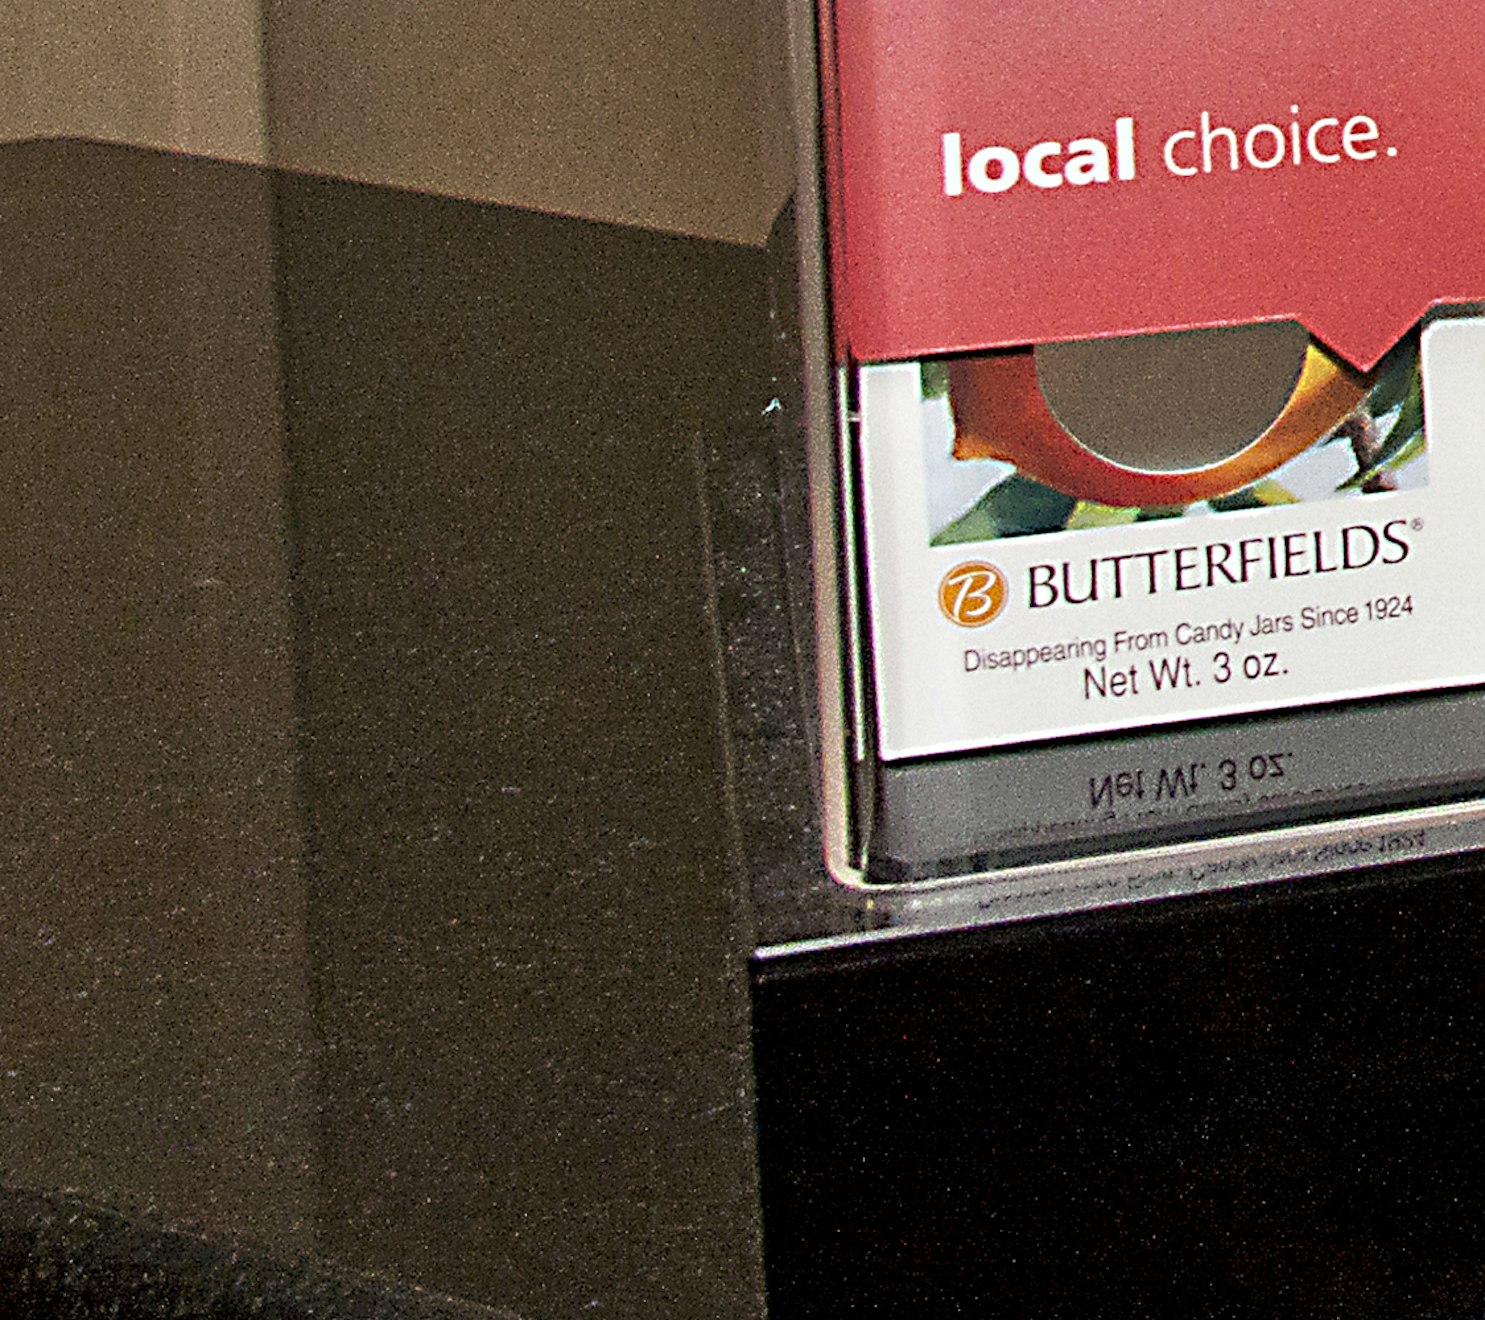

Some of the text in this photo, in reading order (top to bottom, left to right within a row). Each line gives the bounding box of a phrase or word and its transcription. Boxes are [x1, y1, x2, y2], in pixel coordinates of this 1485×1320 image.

[942, 104, 1399, 197] local choice.
[1027, 518, 1412, 610] BUTTERFIELDS
[964, 595, 1414, 675] Disappearing From Candy Jars Since 1924
[1084, 651, 1290, 701] Net Wt. 3 oz.
